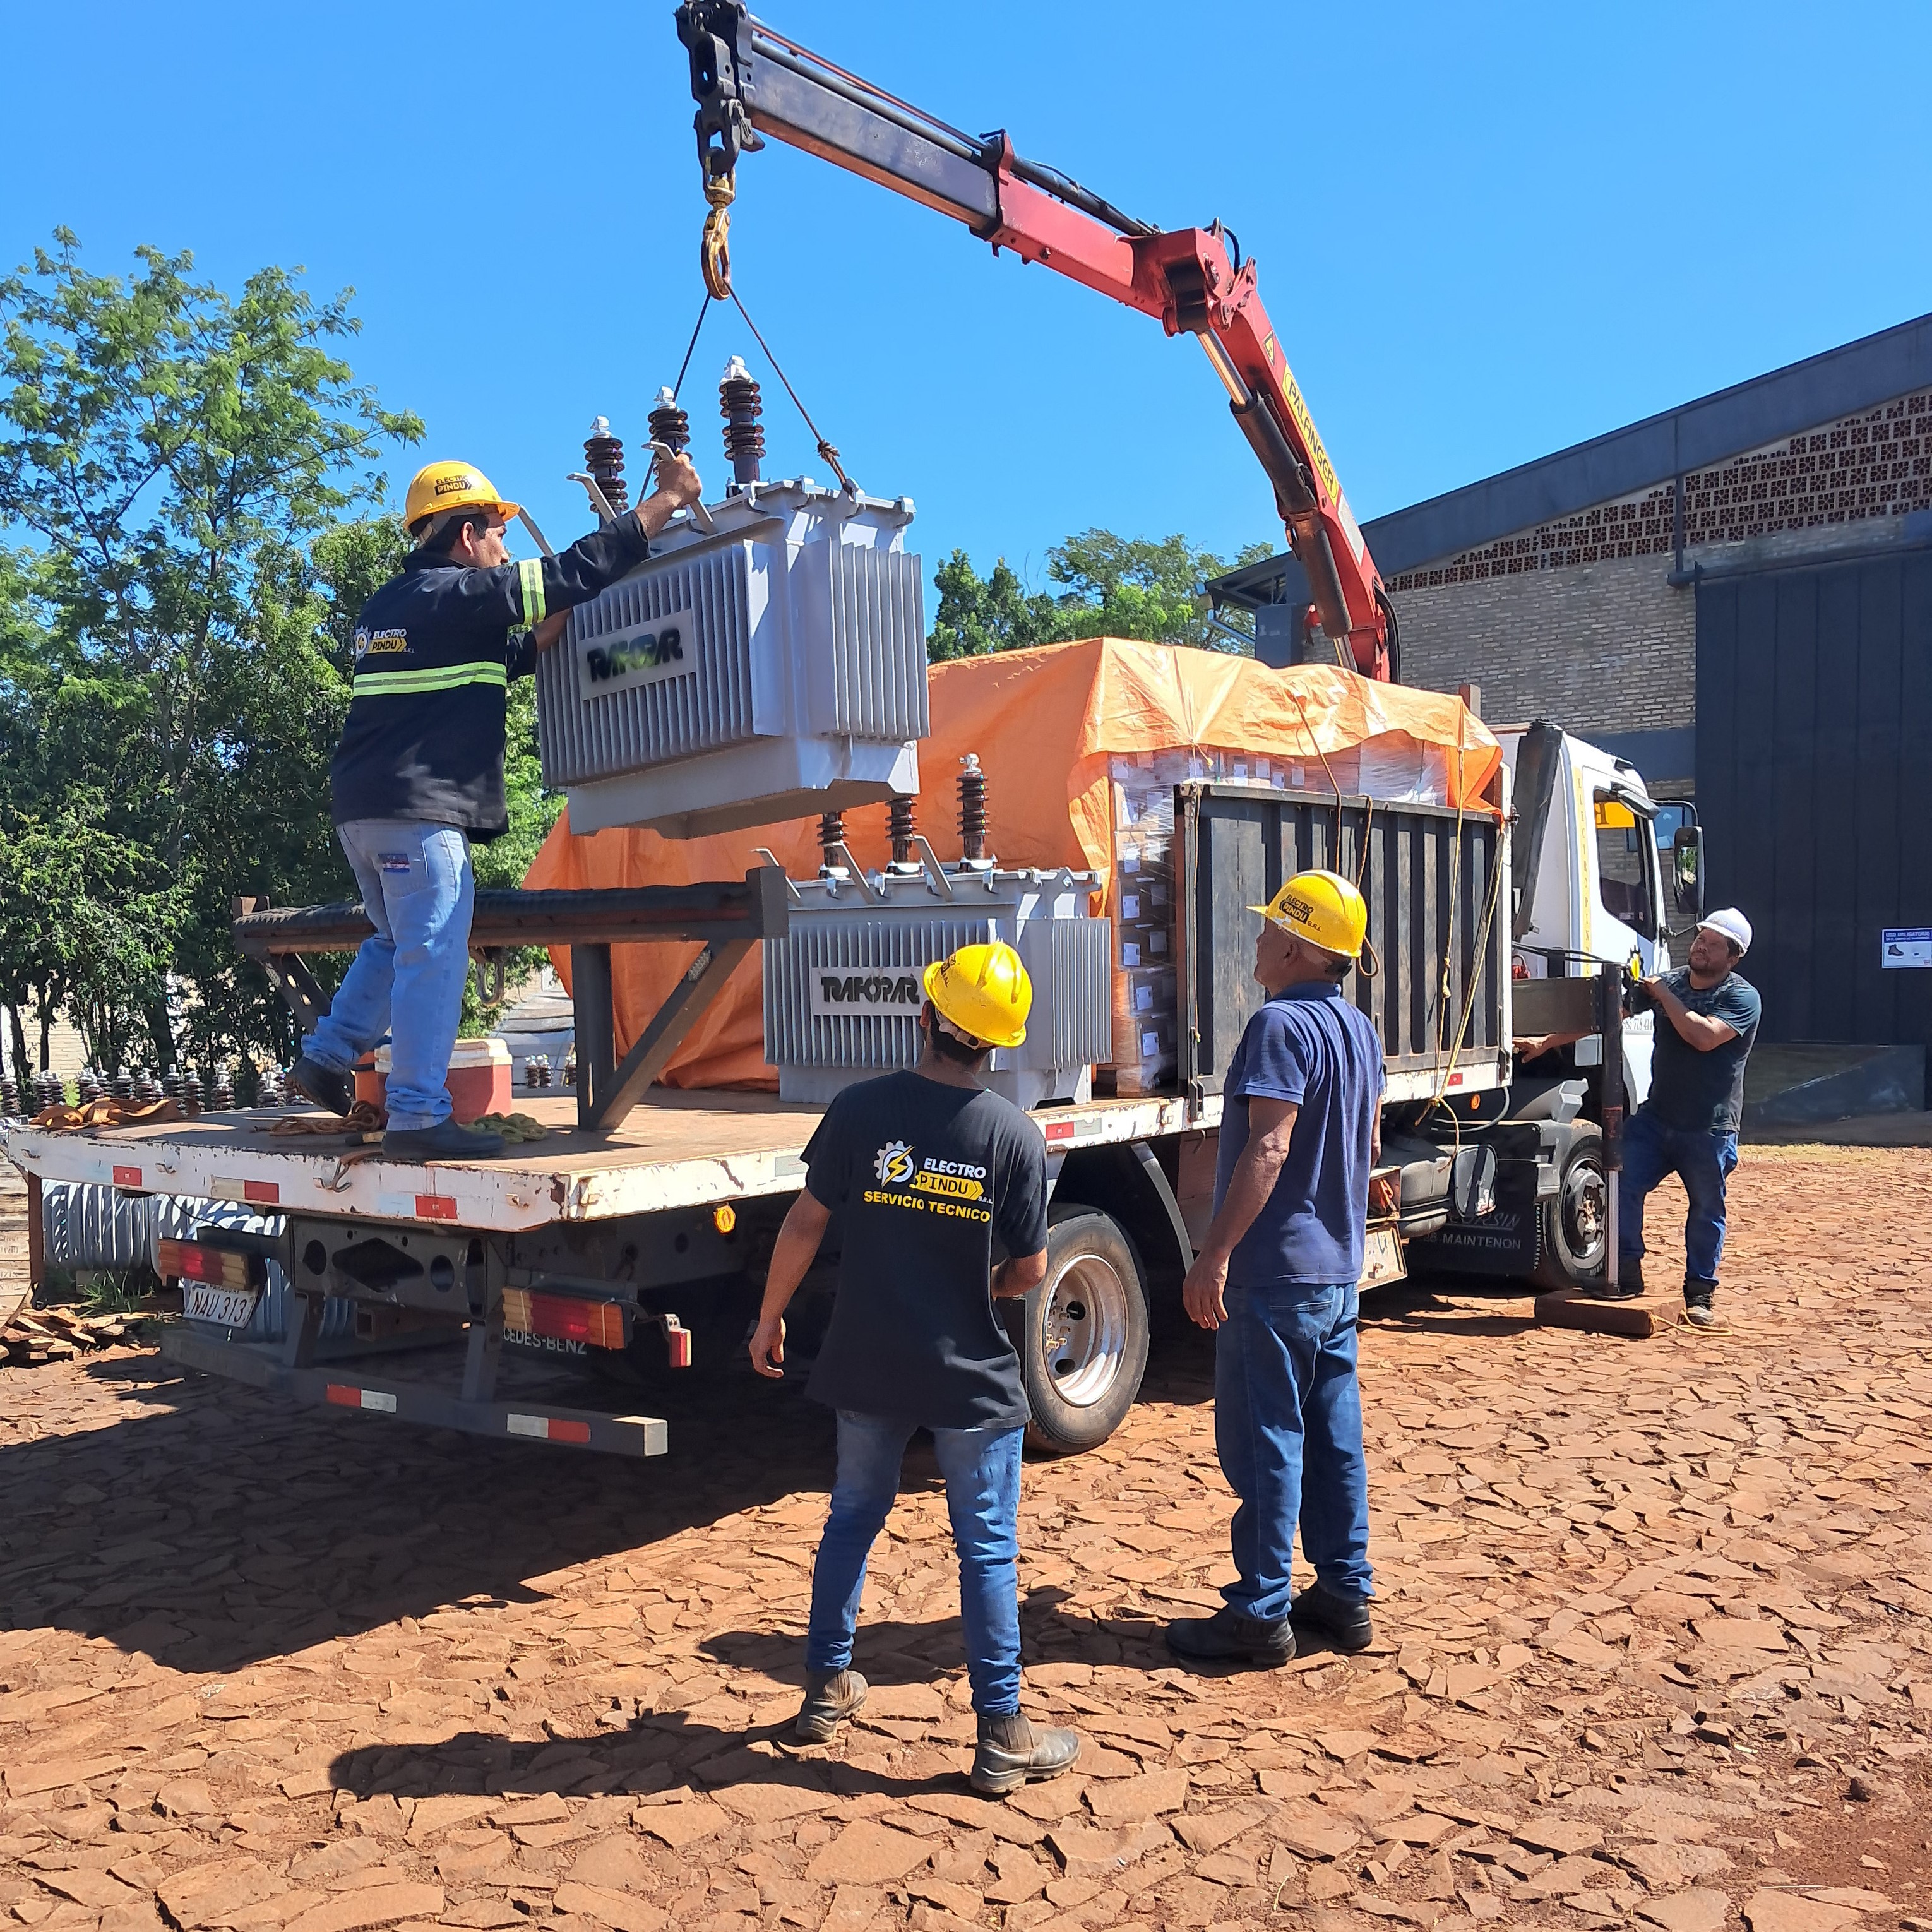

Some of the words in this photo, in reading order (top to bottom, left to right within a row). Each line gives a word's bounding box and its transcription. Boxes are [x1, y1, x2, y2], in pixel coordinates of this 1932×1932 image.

[1289, 379, 1334, 492] PALFINGER
[437, 482, 466, 494] PINDU
[373, 628, 407, 640] ELECTRO
[371, 639, 398, 652] PINDU
[1282, 902, 1308, 921] PINDU
[923, 1157, 987, 1179] ELECTRO
[920, 1174, 969, 1195] PINDU
[863, 1191, 925, 1210] SERVICIO
[927, 1201, 991, 1223] TECNICO
[1443, 1233, 1522, 1249] MAINTENON
[218, 1296, 247, 1323] 313
[503, 1327, 587, 1356] CEDES-BENZ
